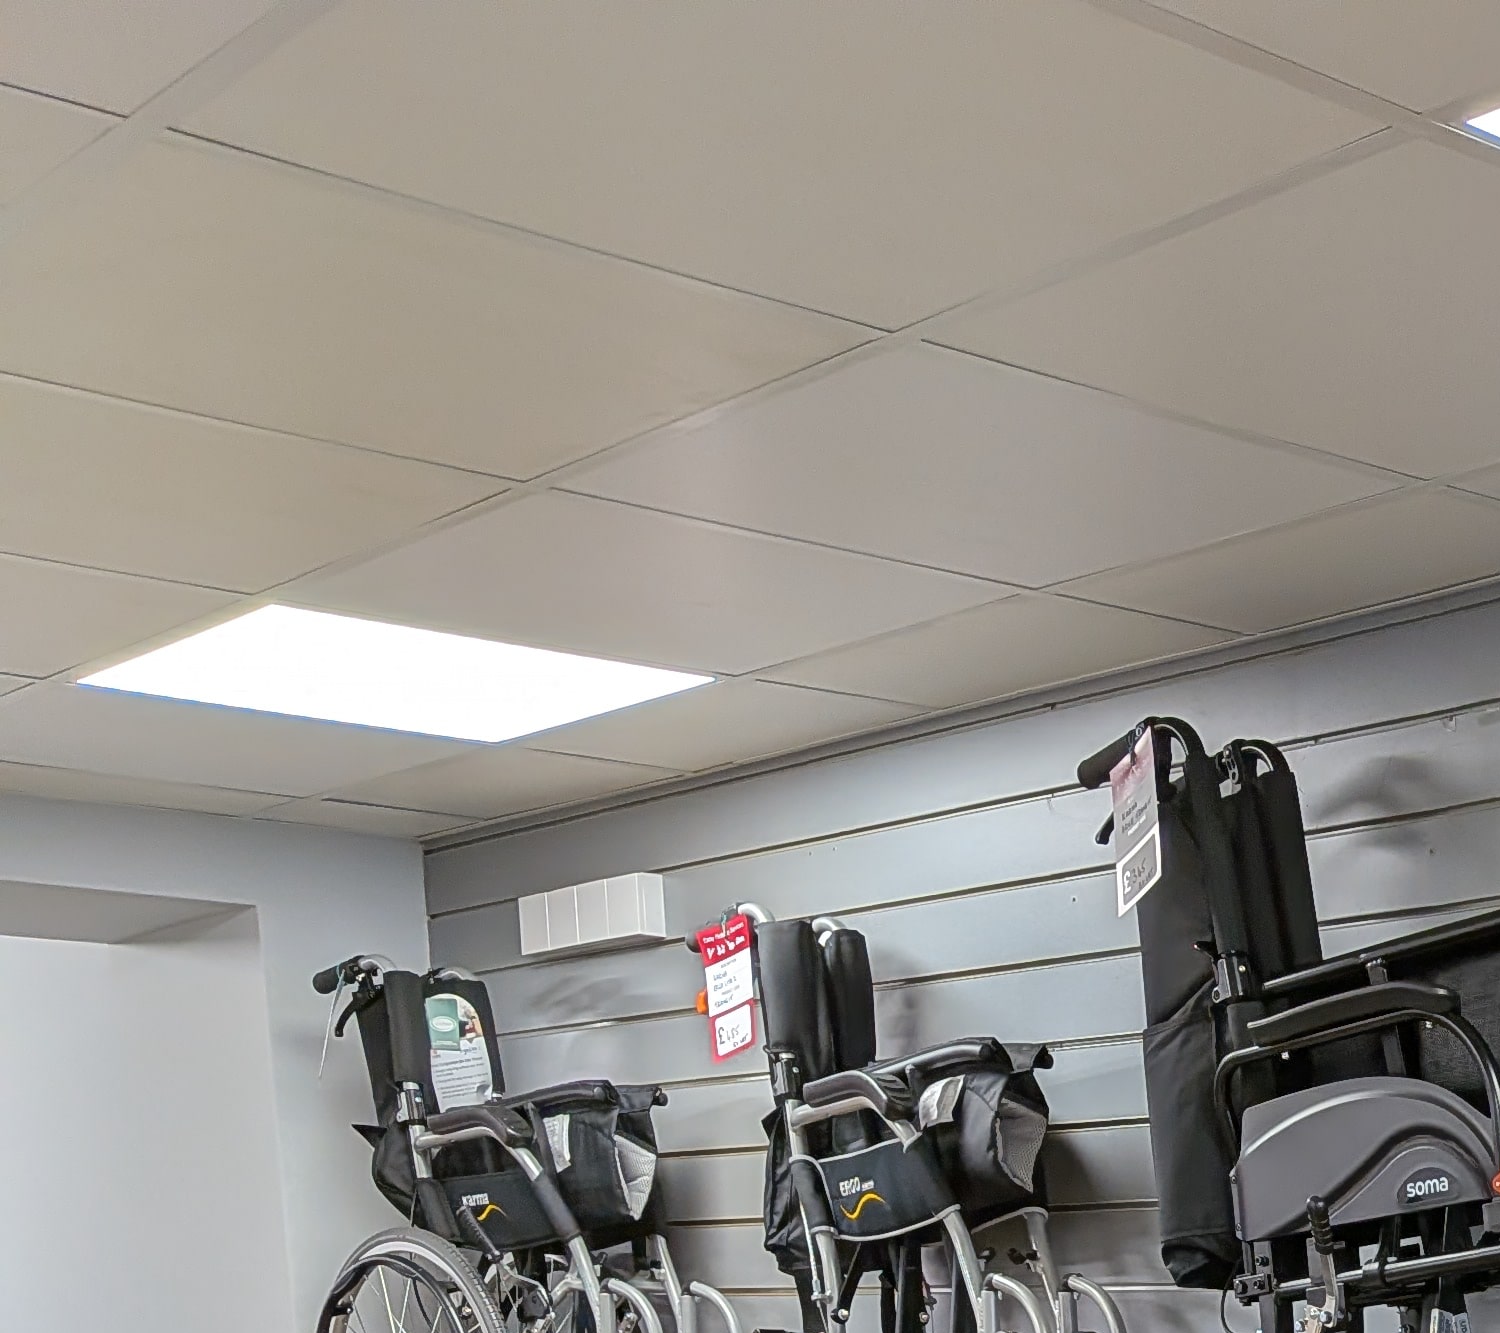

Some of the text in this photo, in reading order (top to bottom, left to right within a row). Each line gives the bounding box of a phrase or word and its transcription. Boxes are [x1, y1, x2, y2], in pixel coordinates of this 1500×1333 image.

[1123, 870, 1131, 894] £
[718, 1027, 725, 1045] £
[1406, 1176, 1449, 1198] soma
